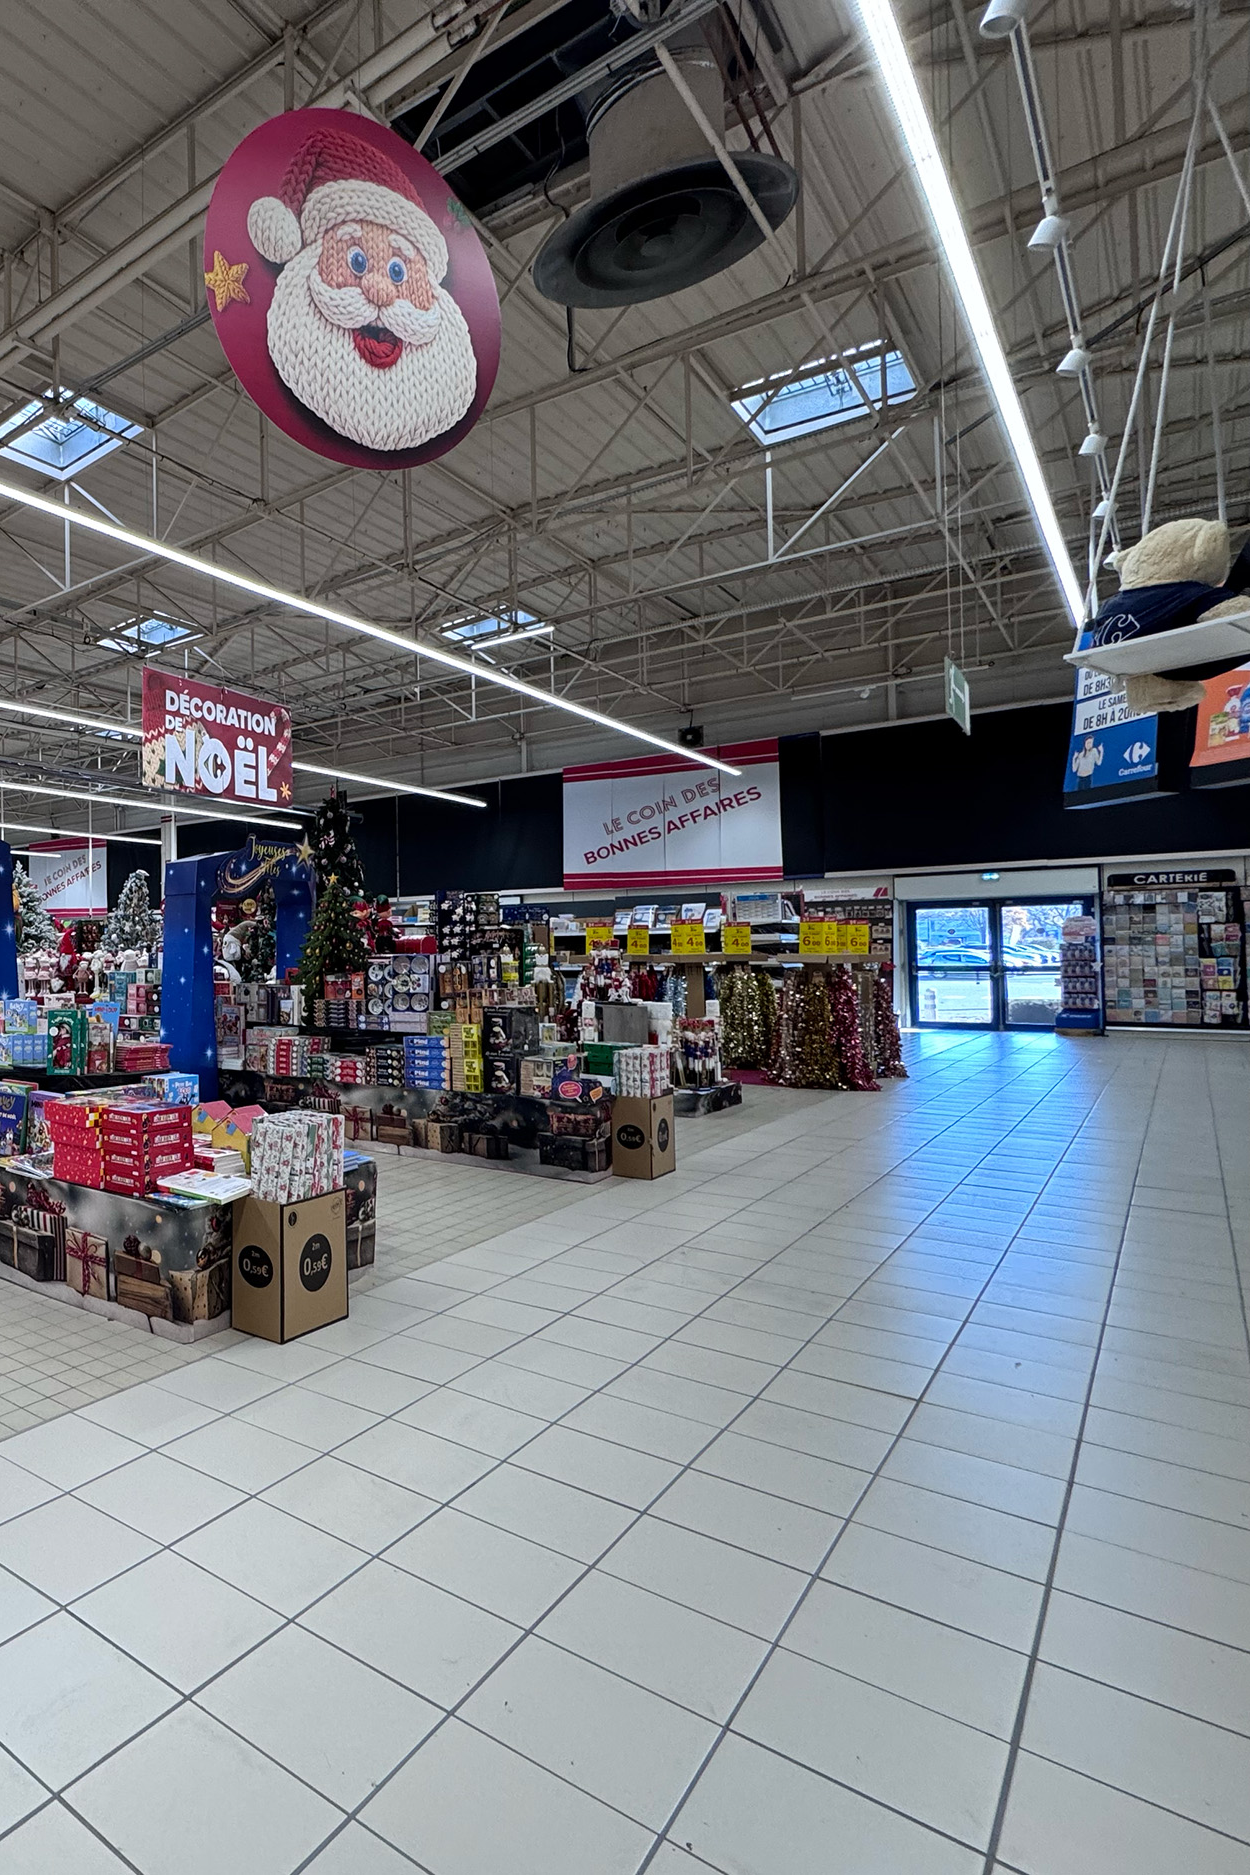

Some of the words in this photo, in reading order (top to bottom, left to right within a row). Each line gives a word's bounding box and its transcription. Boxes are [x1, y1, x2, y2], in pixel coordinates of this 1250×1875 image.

[1084, 684, 1093, 696] DE
[165, 689, 276, 736] DÉCORATION
[1099, 700, 1106, 710] LE
[165, 715, 183, 731] DE
[1083, 717, 1093, 730] DE
[1096, 712, 1108, 727] 8H
[1110, 708, 1116, 722] À
[165, 729, 277, 802] NOËL
[1118, 764, 1153, 776] Carrefour
[603, 817, 623, 835] LE
[627, 795, 678, 826] COIN
[681, 777, 720, 804] DES
[583, 826, 662, 864] BONNES
[666, 786, 762, 835] AFFAIRES
[248, 836, 286, 861] Joyeuses
[52, 864, 71, 880] COIN
[72, 854, 87, 869] DES
[1134, 872, 1208, 884] CARTERIE
[251, 1250, 261, 1258] 2m
[312, 1242, 321, 1251] 2m
[243, 1258, 268, 1278] 0,59€
[304, 1253, 328, 1276] 0,59€
